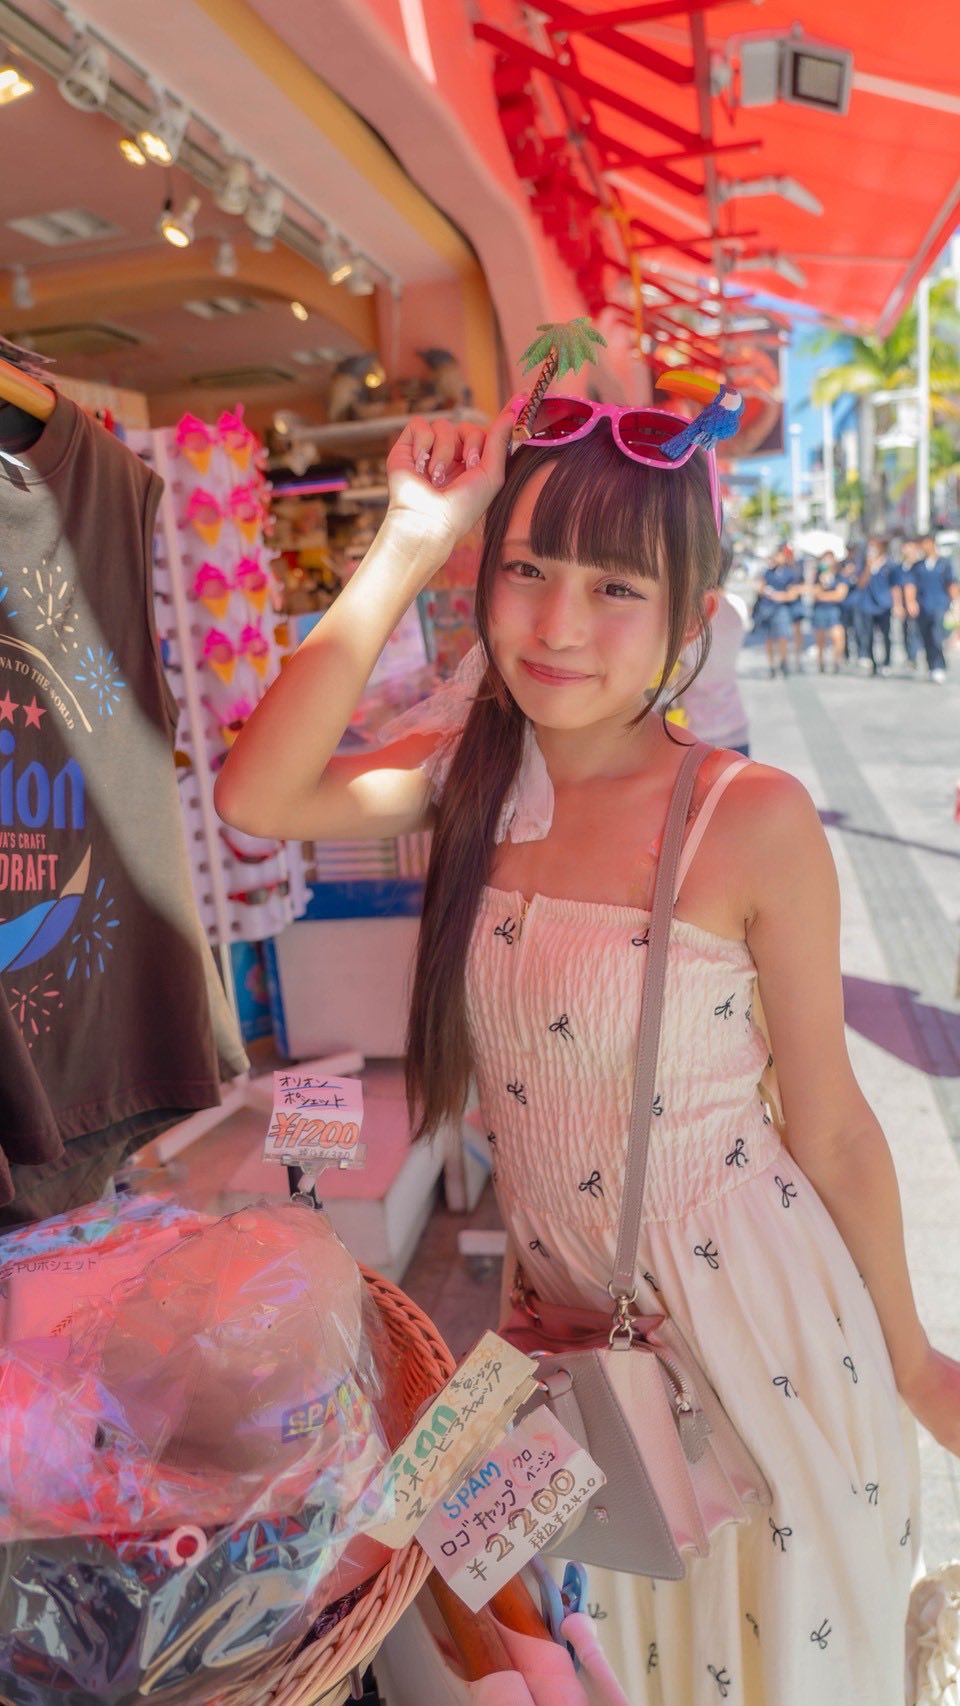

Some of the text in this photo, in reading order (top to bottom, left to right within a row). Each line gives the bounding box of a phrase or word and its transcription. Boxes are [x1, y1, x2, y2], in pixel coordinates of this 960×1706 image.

[14, 660, 30, 676] TO
[30, 668, 51, 691] THE
[18, 832, 47, 850] CRAFT
[284, 1092, 345, 1108] ポシェット
[268, 1112, 360, 1150] ¥1200
[526, 1450, 556, 1481] ベージュ
[442, 1461, 502, 1520] SPAM
[440, 1479, 517, 1557] ロゴキャップ
